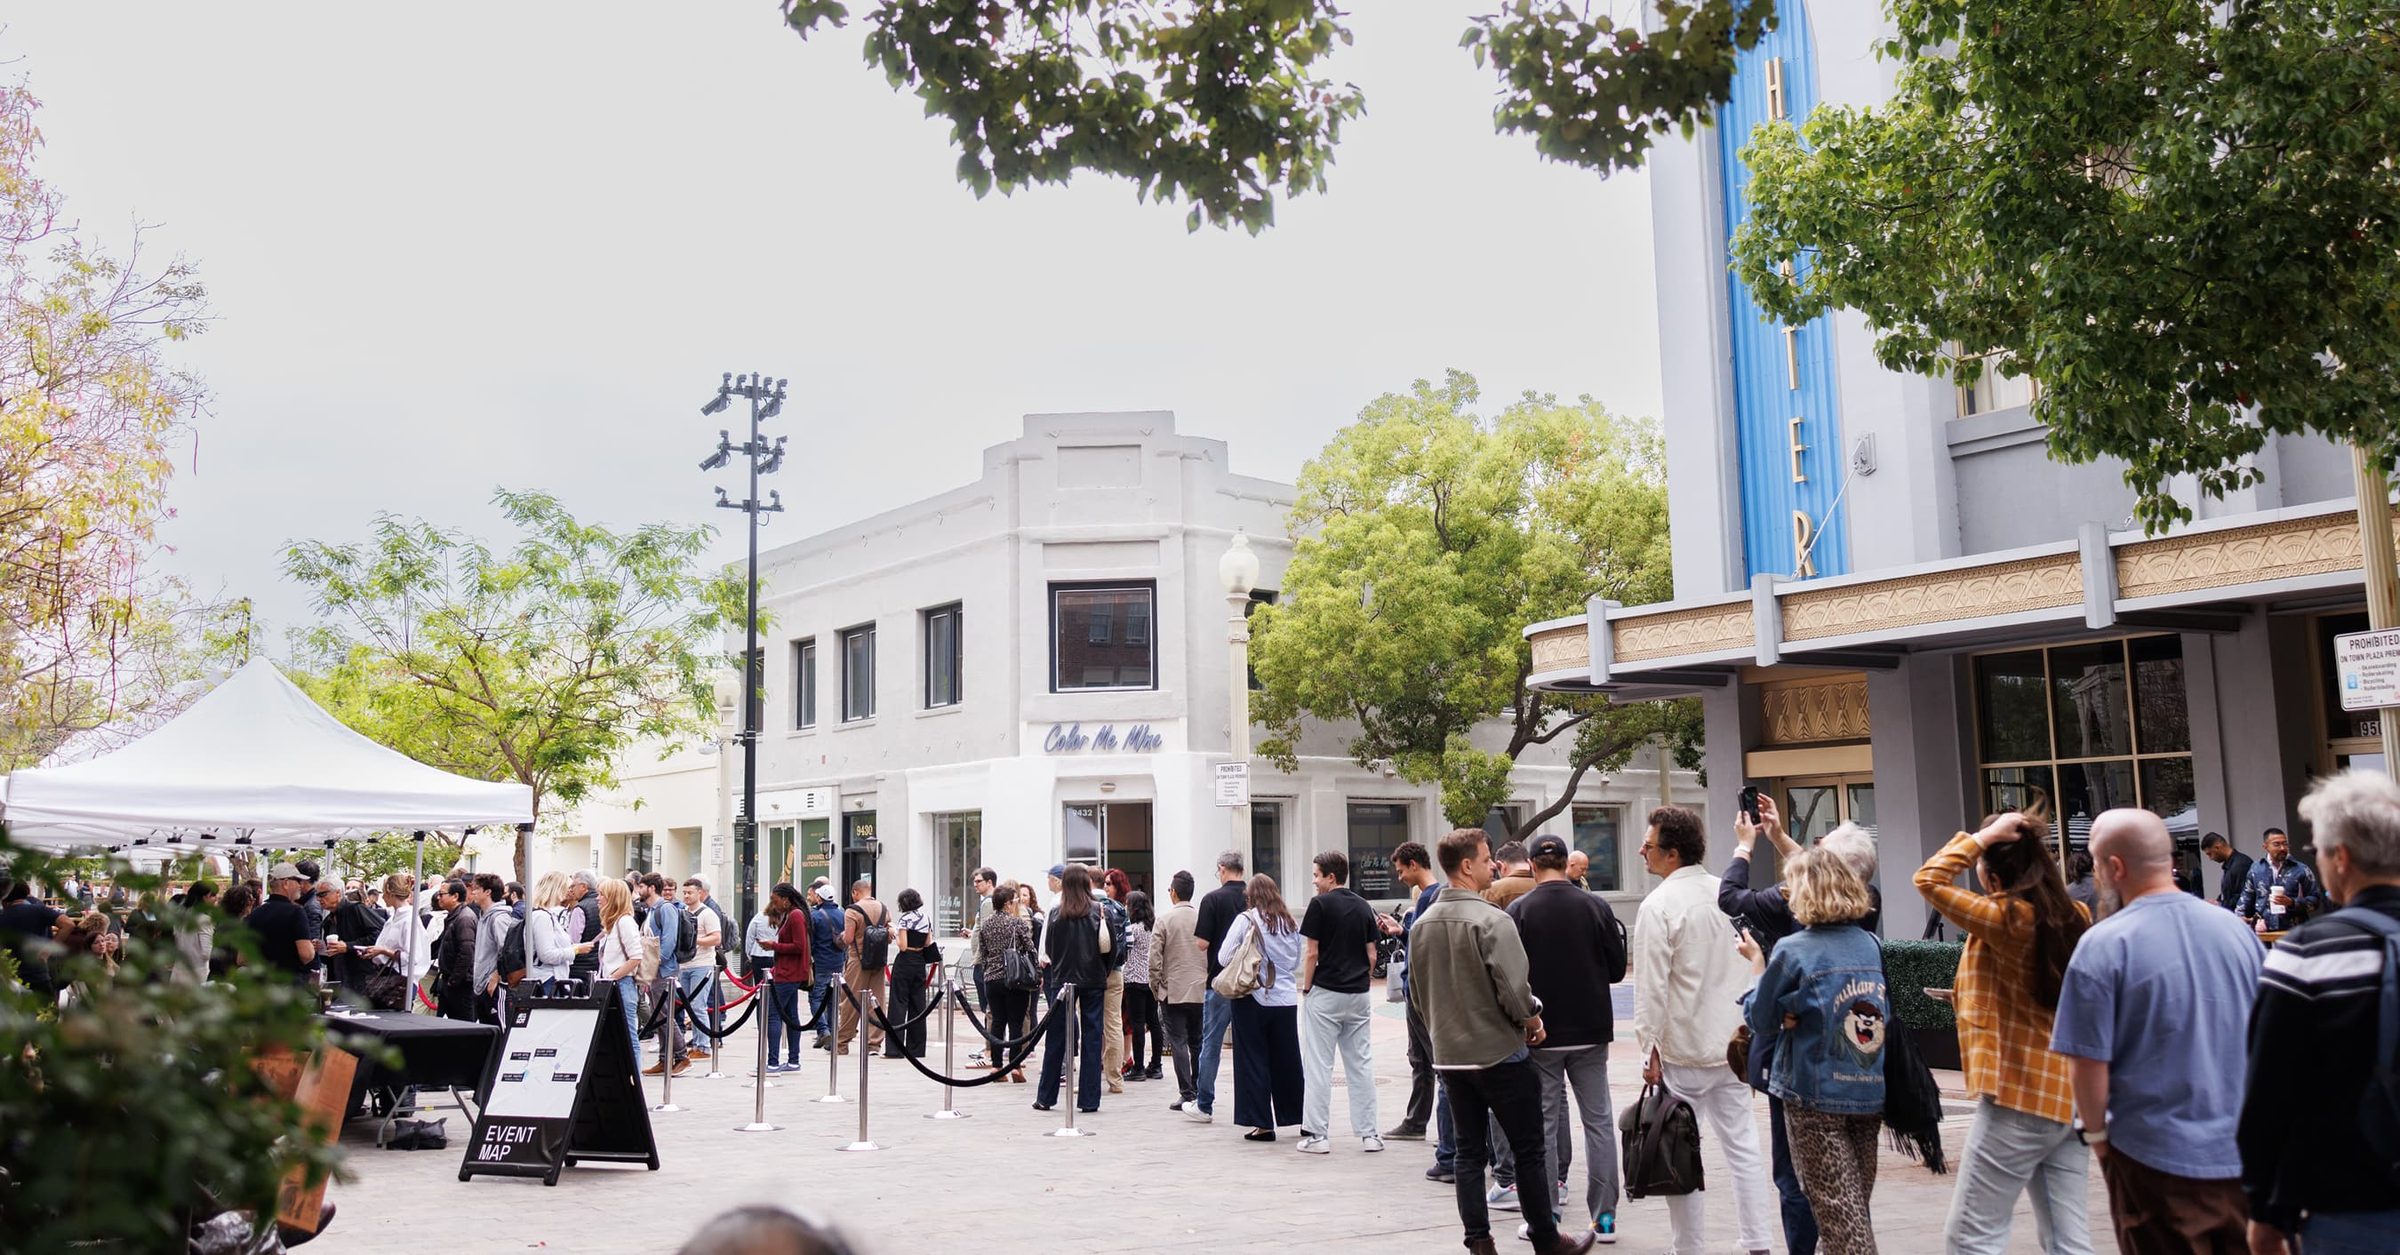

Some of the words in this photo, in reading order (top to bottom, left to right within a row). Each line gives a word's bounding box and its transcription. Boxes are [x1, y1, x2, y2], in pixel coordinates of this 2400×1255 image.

[2349, 633, 2400, 650] PROHIBITED
[2339, 655, 2348, 663] ON
[2348, 653, 2365, 662] TOWN
[2365, 651, 2384, 660] PLAZA
[1044, 720, 1090, 753] Color
[1091, 724, 1118, 751] Me
[1121, 724, 1163, 753] Mine
[1072, 808, 1093, 817] 9432
[856, 824, 874, 837] 9430
[485, 1125, 537, 1143] EVENT
[478, 1143, 511, 1161] MAP
